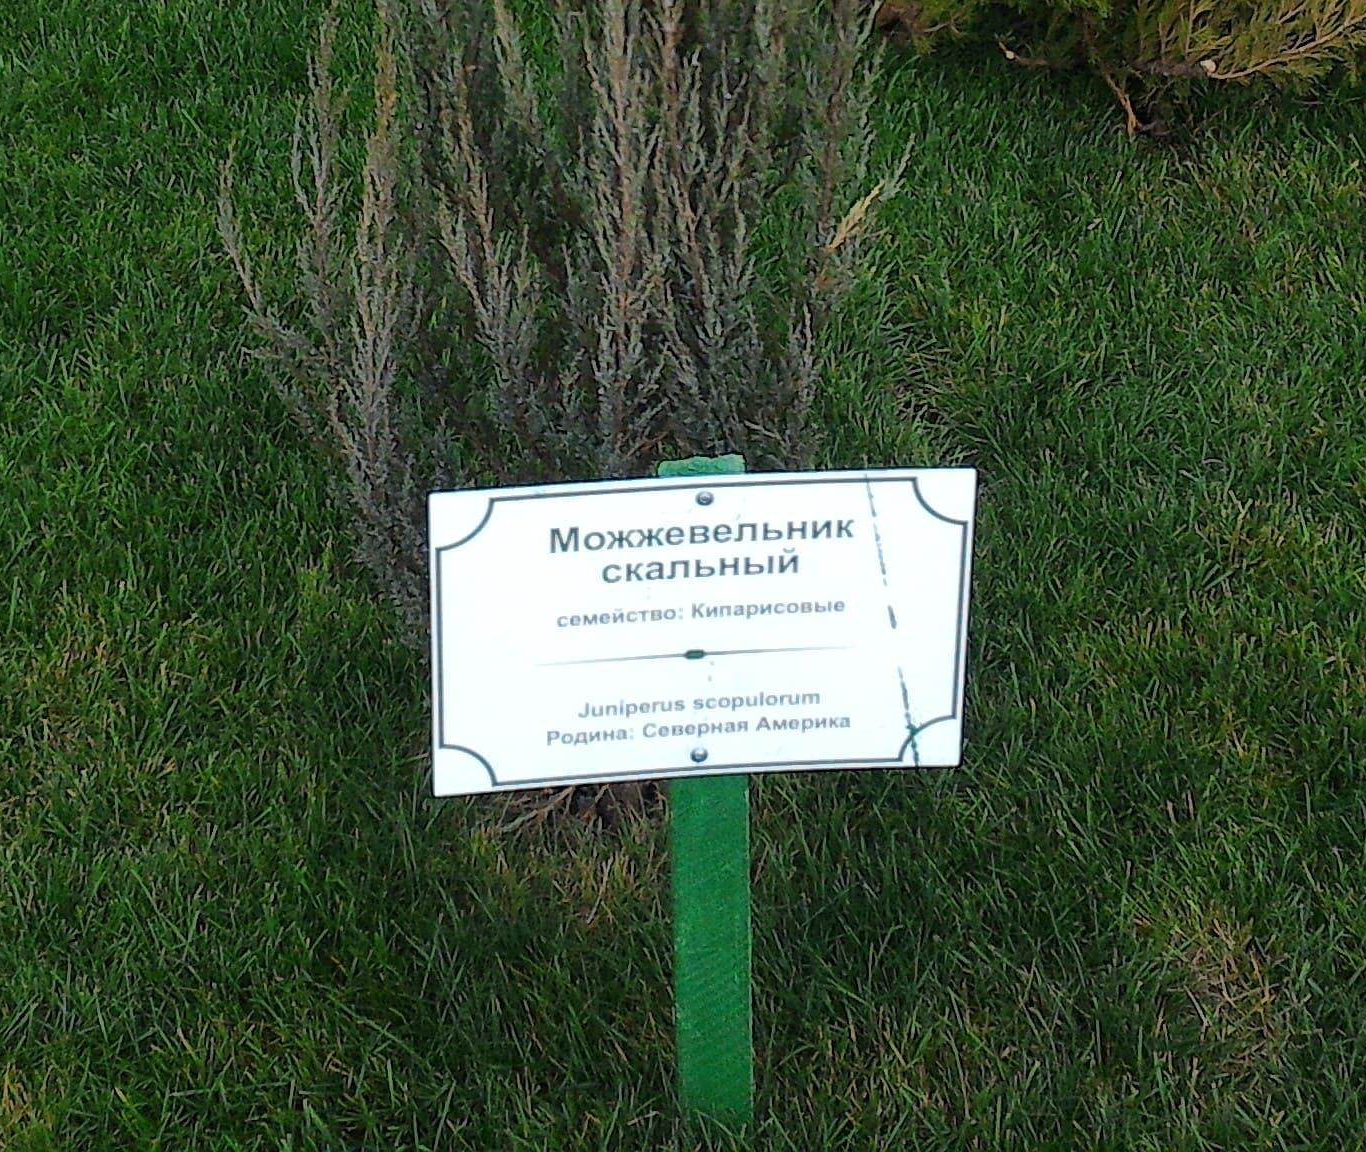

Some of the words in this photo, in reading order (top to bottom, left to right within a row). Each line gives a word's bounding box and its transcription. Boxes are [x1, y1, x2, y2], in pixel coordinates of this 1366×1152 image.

[549, 519, 855, 554] Можжевельник
[601, 549, 800, 583] скальный
[556, 606, 684, 628] семейство:
[691, 598, 846, 620] Кипарисовые
[578, 695, 686, 719] Juniperus
[692, 691, 821, 714] scopulorum
[546, 726, 635, 747] Родина:
[642, 720, 749, 742] Северная
[755, 713, 851, 735] Америка
